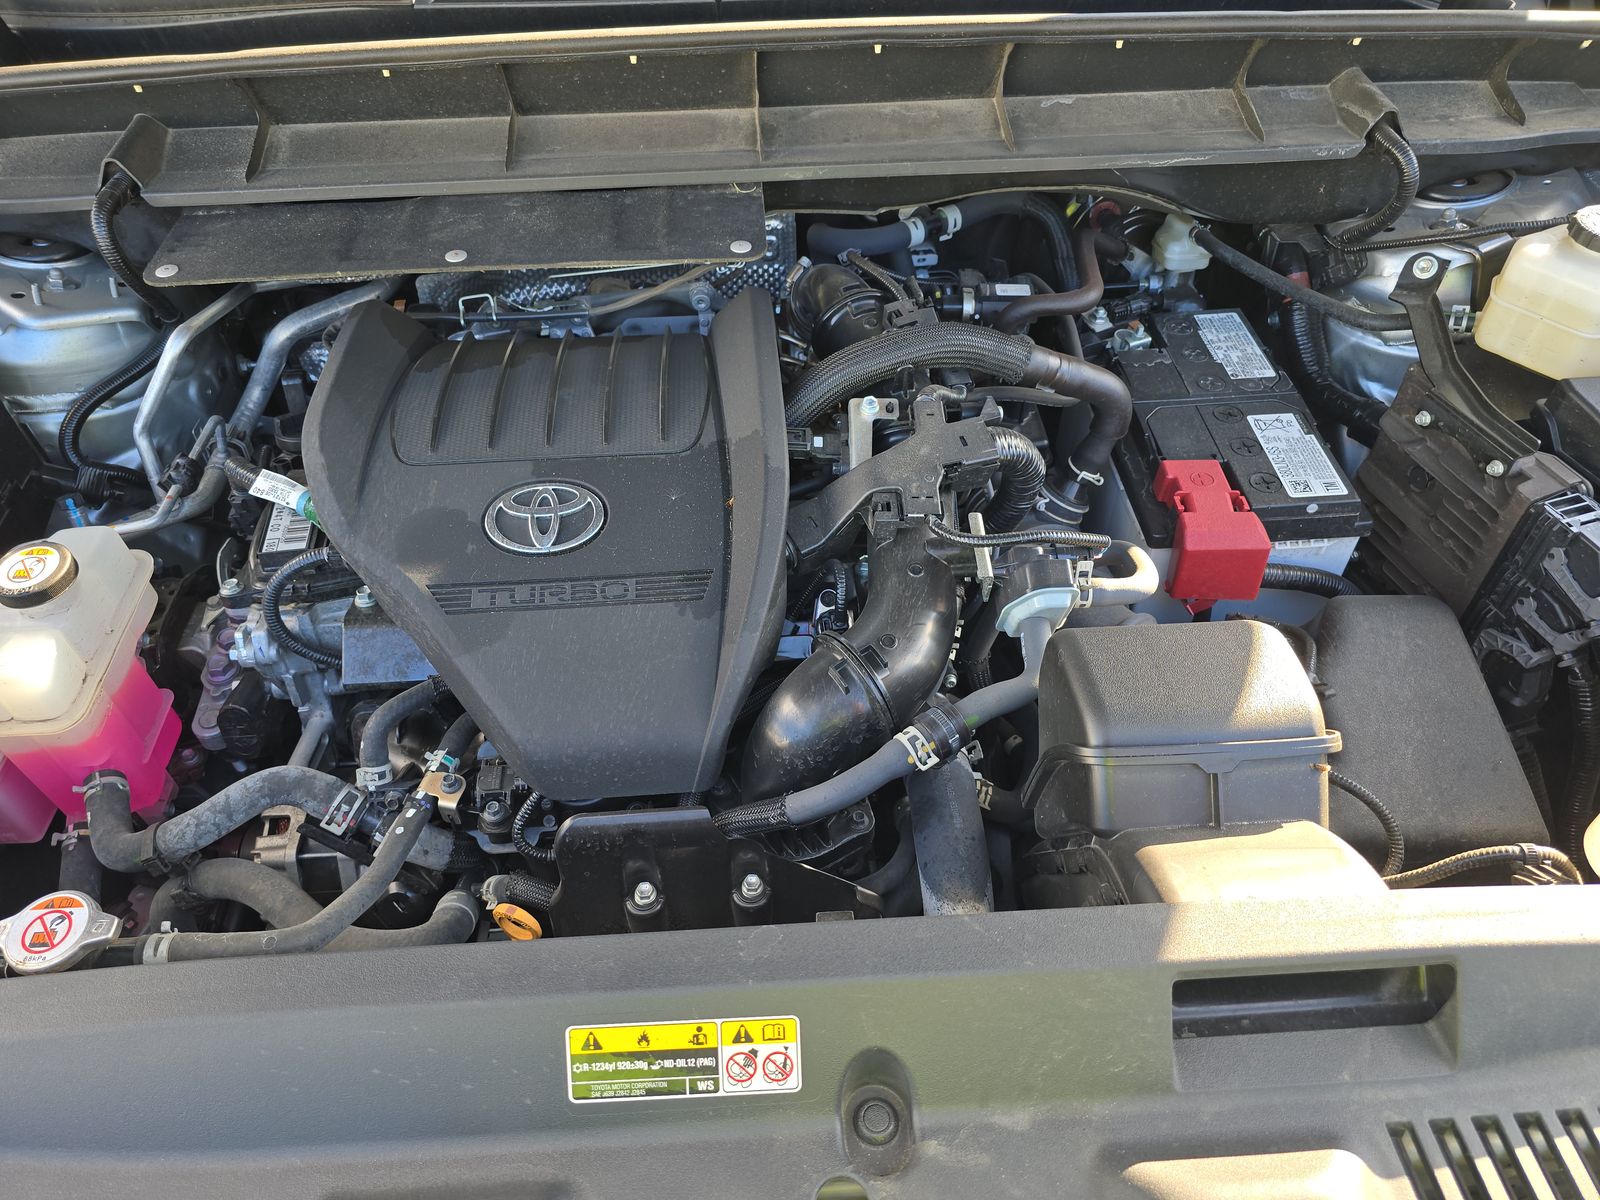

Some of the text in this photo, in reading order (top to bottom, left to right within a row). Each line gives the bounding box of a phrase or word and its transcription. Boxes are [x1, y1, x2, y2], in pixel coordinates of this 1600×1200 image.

[477, 581, 630, 607] TURBO
[663, 1057, 716, 1068] ND-OIL12 (PAG)
[631, 1081, 668, 1089] CORPORATION
[696, 1080, 715, 1091] WS
